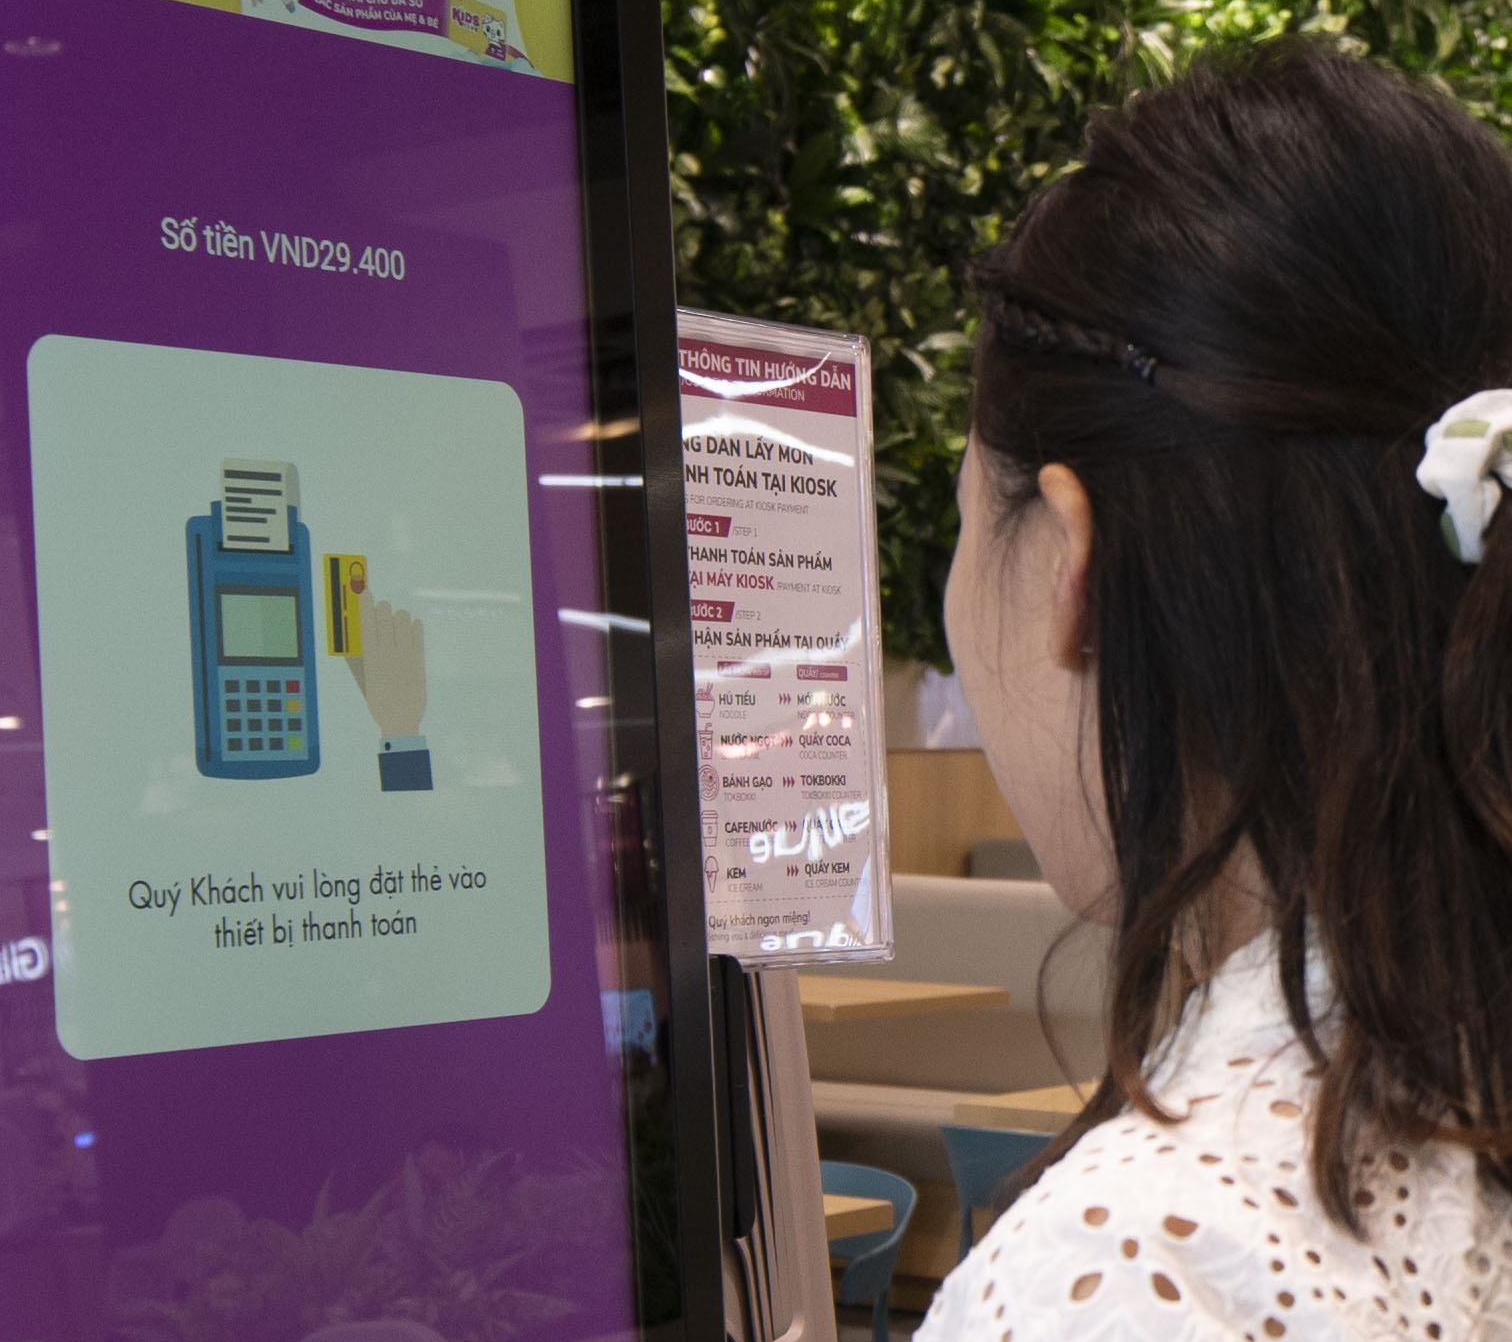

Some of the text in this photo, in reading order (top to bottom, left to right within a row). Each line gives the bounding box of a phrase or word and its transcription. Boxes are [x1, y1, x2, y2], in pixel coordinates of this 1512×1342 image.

[160, 216, 405, 280] Số tiền VND29.400
[678, 347, 731, 376] THÔNG
[736, 358, 760, 379] TIN
[821, 365, 851, 391] DẪN
[714, 463, 837, 498] TOÁN TẠI KIOSK
[731, 547, 765, 567] TOÁN
[769, 549, 794, 568] SẢN
[798, 550, 832, 571] PHẨM
[688, 570, 703, 589] ẠI
[707, 568, 732, 588] MÁY
[736, 573, 775, 591] KIOSK
[690, 603, 714, 619] ƯỚC
[726, 627, 752, 648] SẢN
[755, 629, 791, 649] PHẨM
[826, 735, 851, 746] COCA
[722, 773, 773, 791] BÁNH GẠO
[800, 775, 846, 786] TOKBOKKI
[727, 867, 747, 879] KEM
[831, 862, 850, 875] KEM
[128, 863, 487, 917] Quý Khách vui lòng đặt thẻ vào
[214, 910, 417, 950] thiết bị thanh toán
[757, 915, 780, 927] ngon
